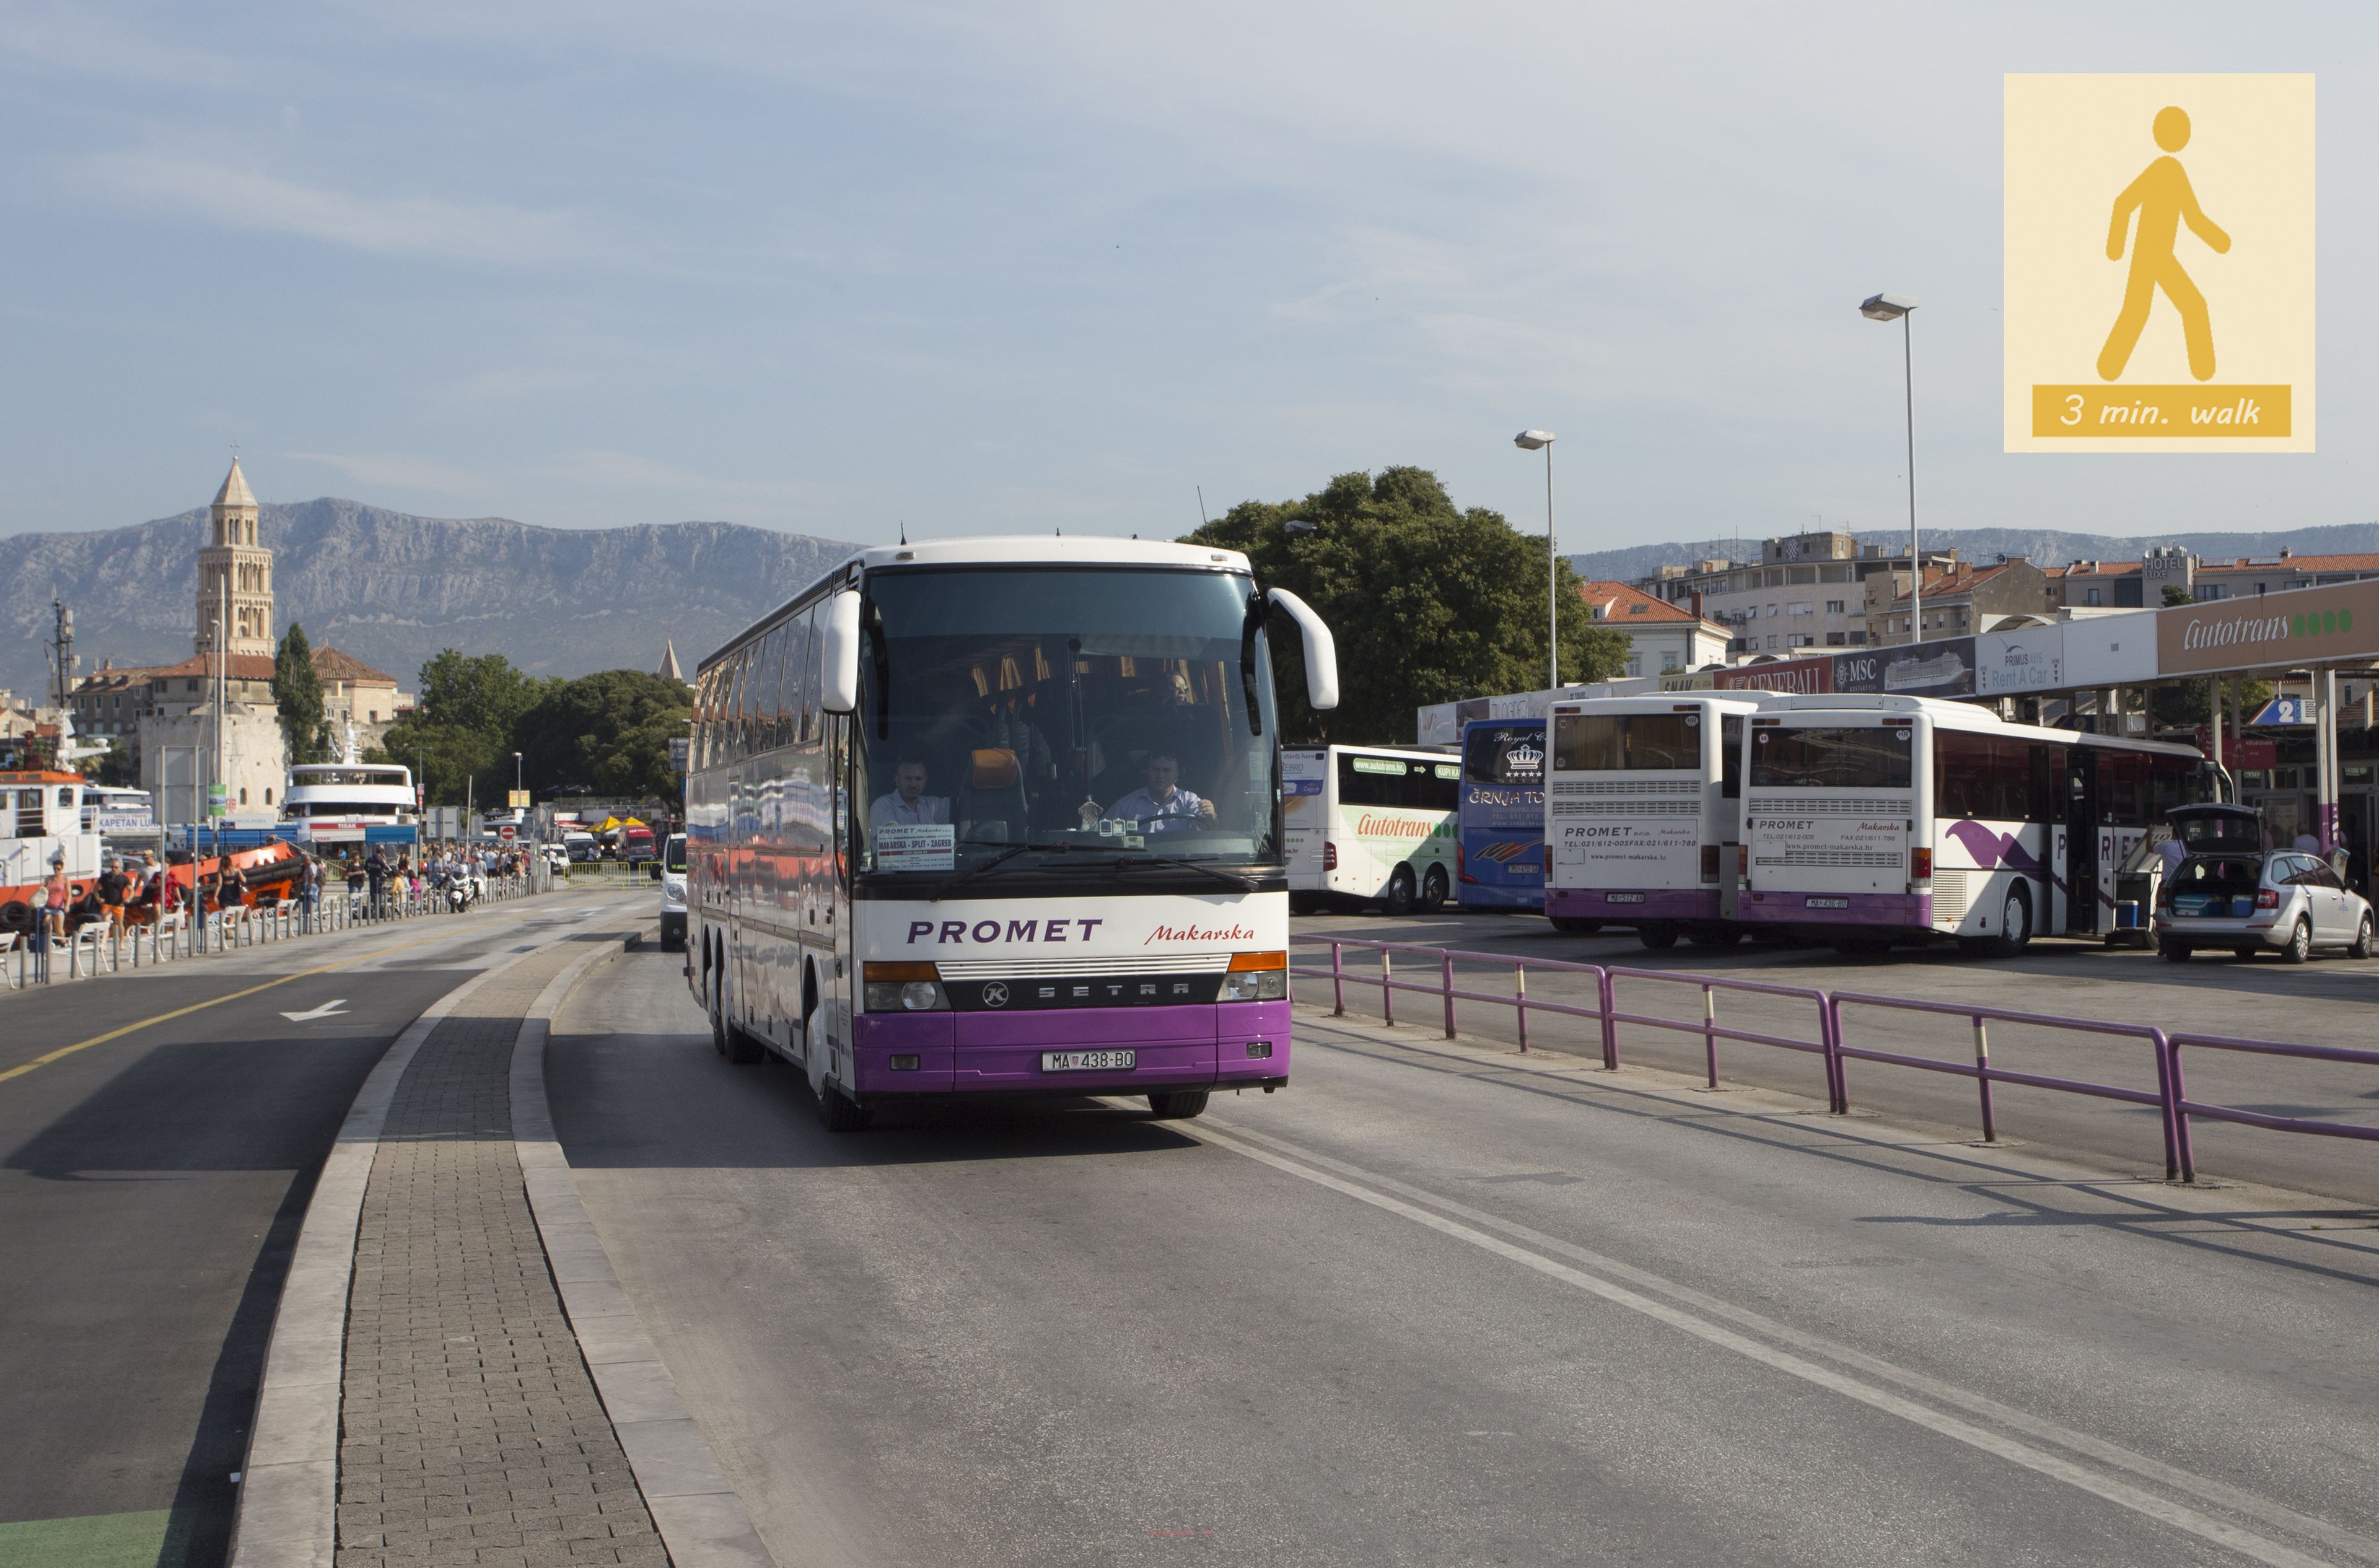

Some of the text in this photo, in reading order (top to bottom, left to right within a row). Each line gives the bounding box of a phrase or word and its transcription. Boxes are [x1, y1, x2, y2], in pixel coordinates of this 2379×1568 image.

[2145, 558, 2184, 569] HOTEL
[2145, 570, 2167, 579] LUXE
[2005, 652, 2043, 667] PRIMUS AVIS
[1849, 659, 1877, 681] MSC
[1992, 667, 2048, 687] Rent A Car
[2278, 701, 2294, 722] 2
[1494, 732, 1533, 745] Royal
[1355, 761, 1403, 771] www.autotrans.hr
[1437, 768, 1451, 776] KUPI
[100, 818, 137, 827] KAPETAN
[1759, 821, 1900, 831] PROMET Makarska
[1565, 827, 1632, 837] PROMET
[879, 841, 906, 849] MAKARSKA
[911, 840, 926, 848] SPLIT
[931, 839, 952, 848] ZAGREB
[1786, 843, 1873, 851] www.promet-makarska.hr
[906, 918, 1255, 945] PROMET Makarska
[1039, 983, 1190, 998] SETRA
[1053, 1054, 1070, 1068] MA
